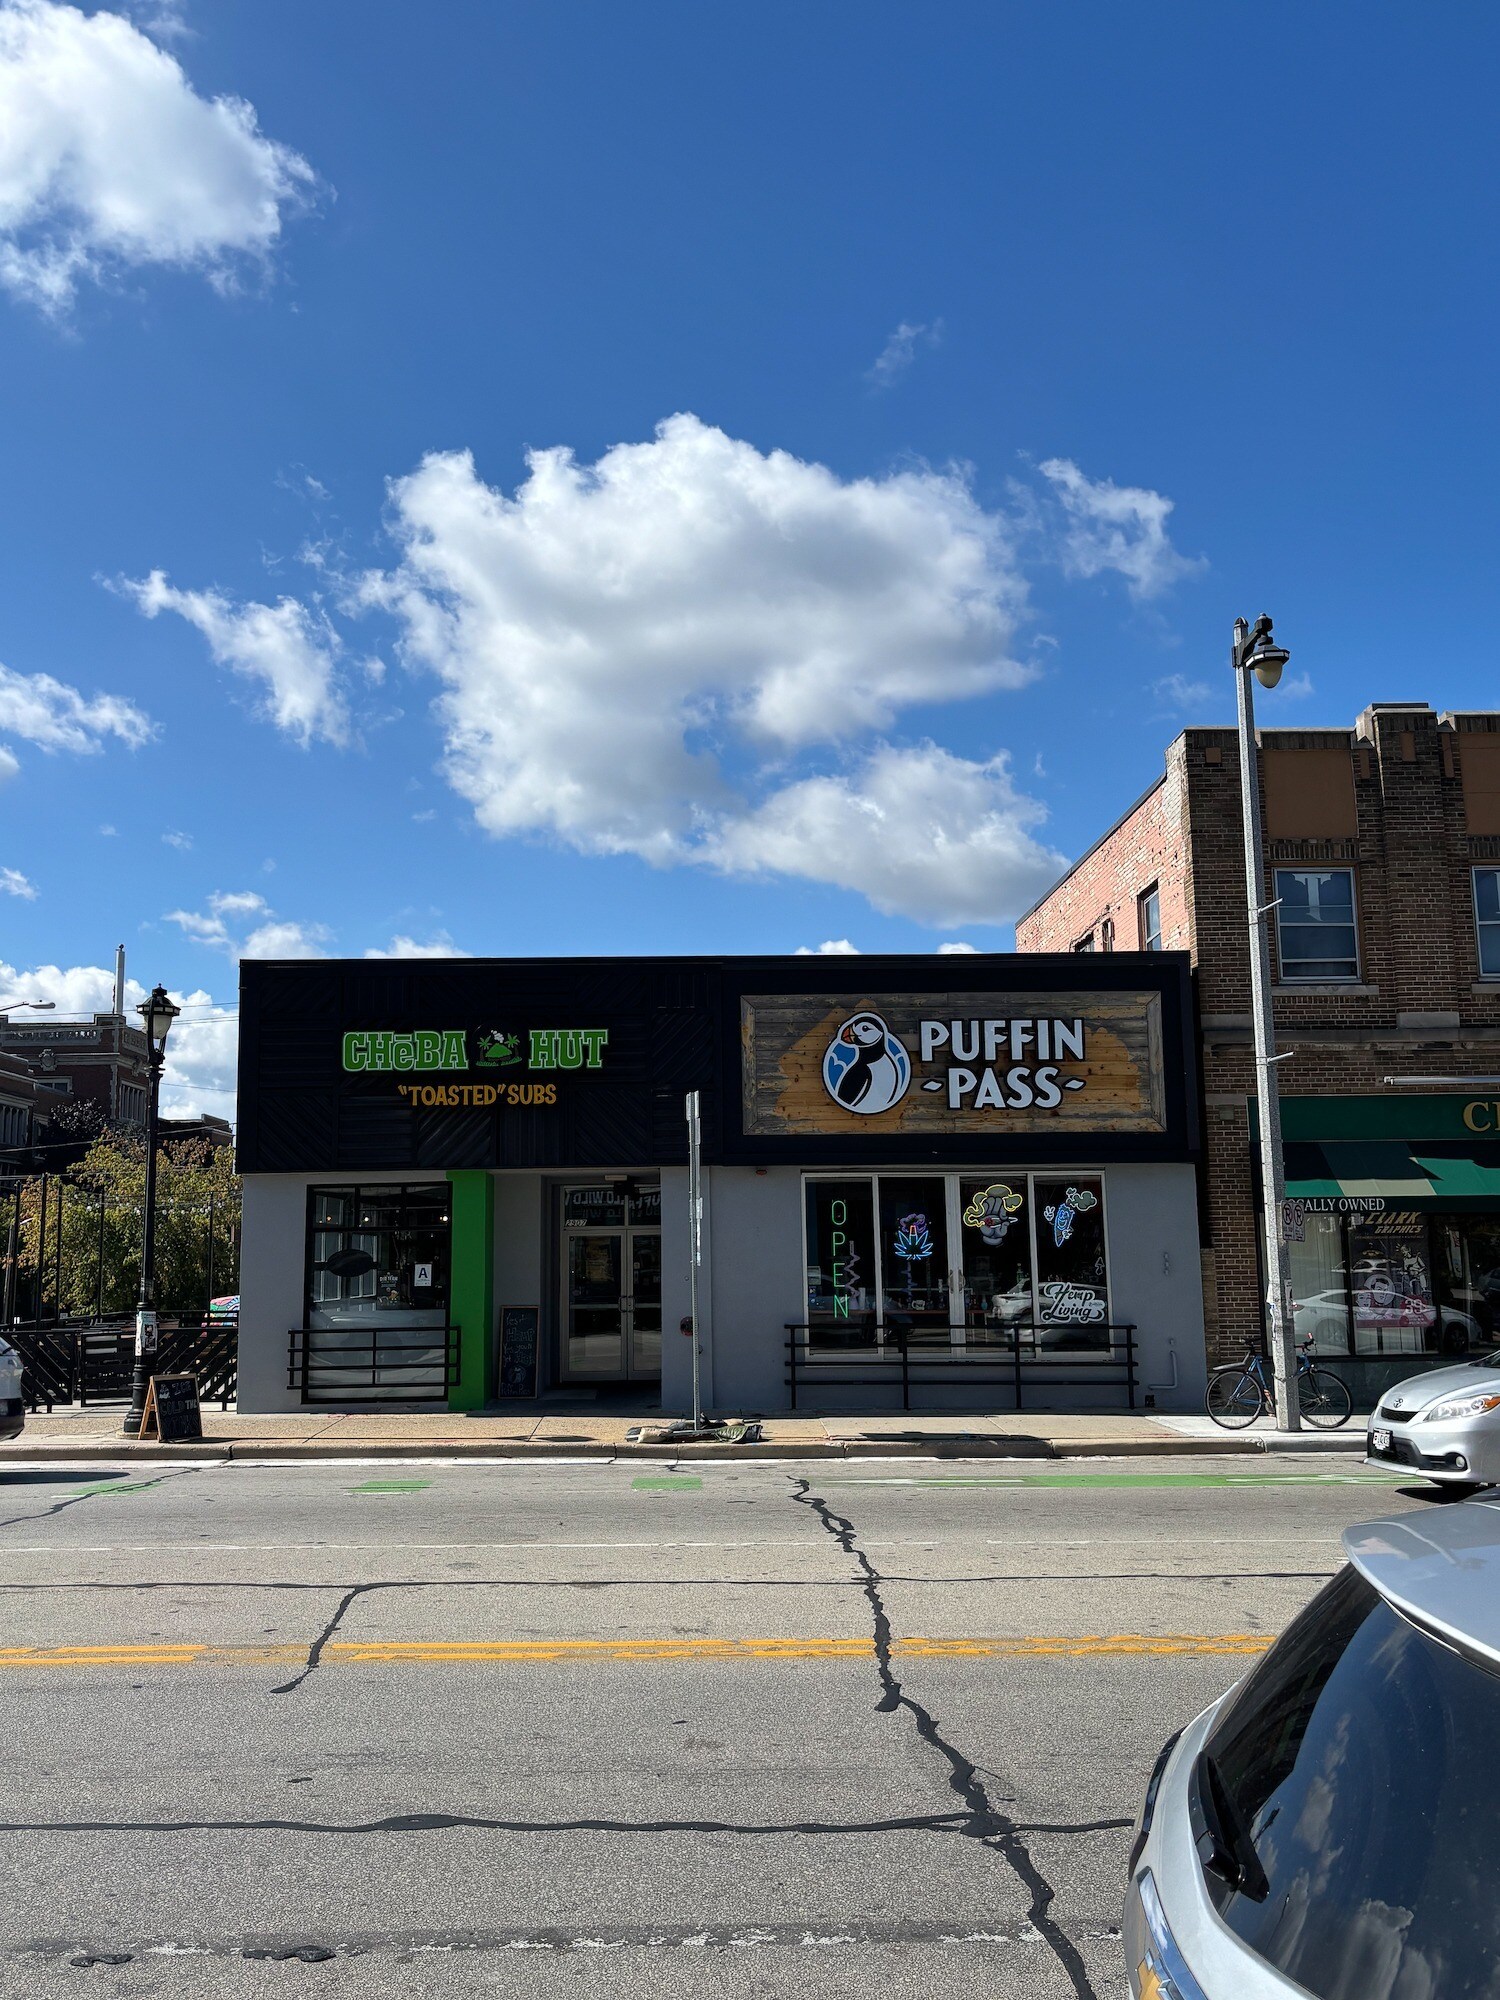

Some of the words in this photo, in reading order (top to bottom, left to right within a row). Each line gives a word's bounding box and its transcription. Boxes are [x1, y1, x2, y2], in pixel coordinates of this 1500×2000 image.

[528, 1029, 609, 1069] HUT
[920, 1019, 1084, 1061] PUFFIN
[507, 1084, 557, 1105] SUBS
[1339, 1198, 1385, 1211] OWNED
[1364, 1211, 1422, 1225] CLARK
[1374, 1225, 1424, 1234] GRAPHICS
[831, 1200, 849, 1318] OPEN
[418, 1267, 428, 1279] A
[1045, 1283, 1094, 1306] Hemp
[1042, 1302, 1103, 1321] Living
